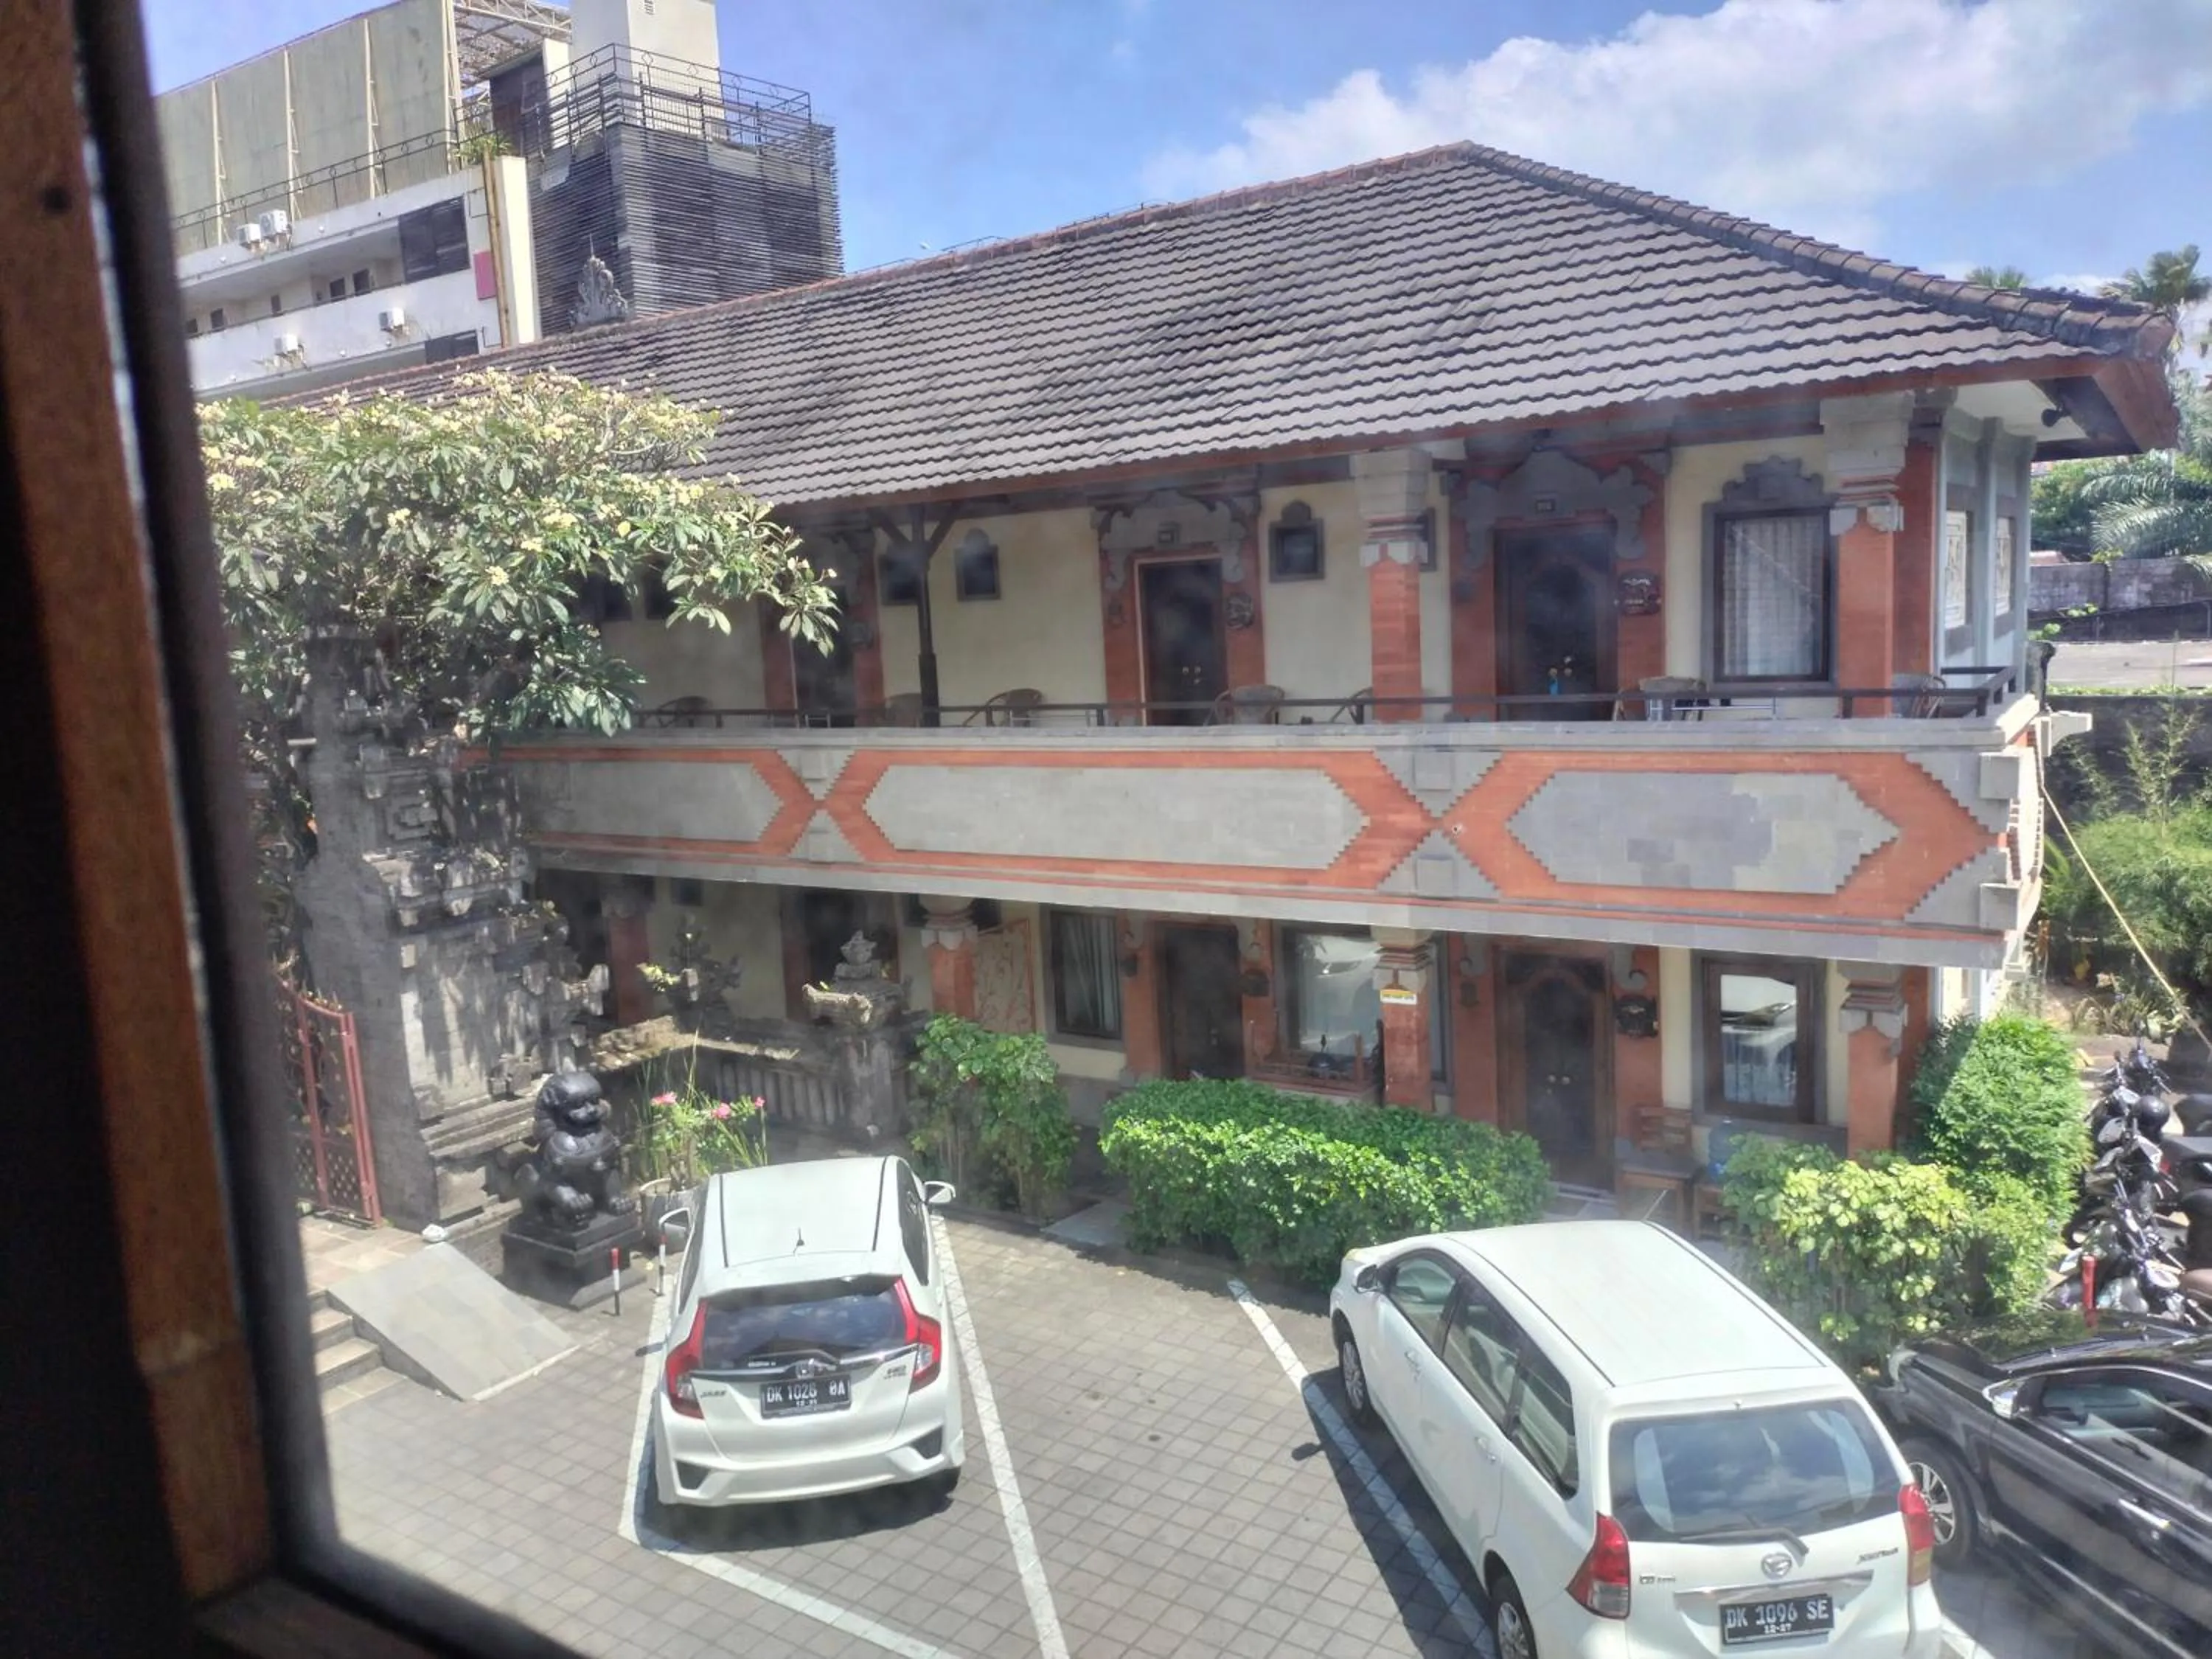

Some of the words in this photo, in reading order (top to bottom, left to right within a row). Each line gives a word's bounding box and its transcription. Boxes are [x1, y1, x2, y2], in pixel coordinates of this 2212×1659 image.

[767, 1386, 782, 1402] DK
[1725, 1607, 1748, 1628] DK
[1755, 1602, 1798, 1625] 1096
[1806, 1599, 1829, 1620] SE
